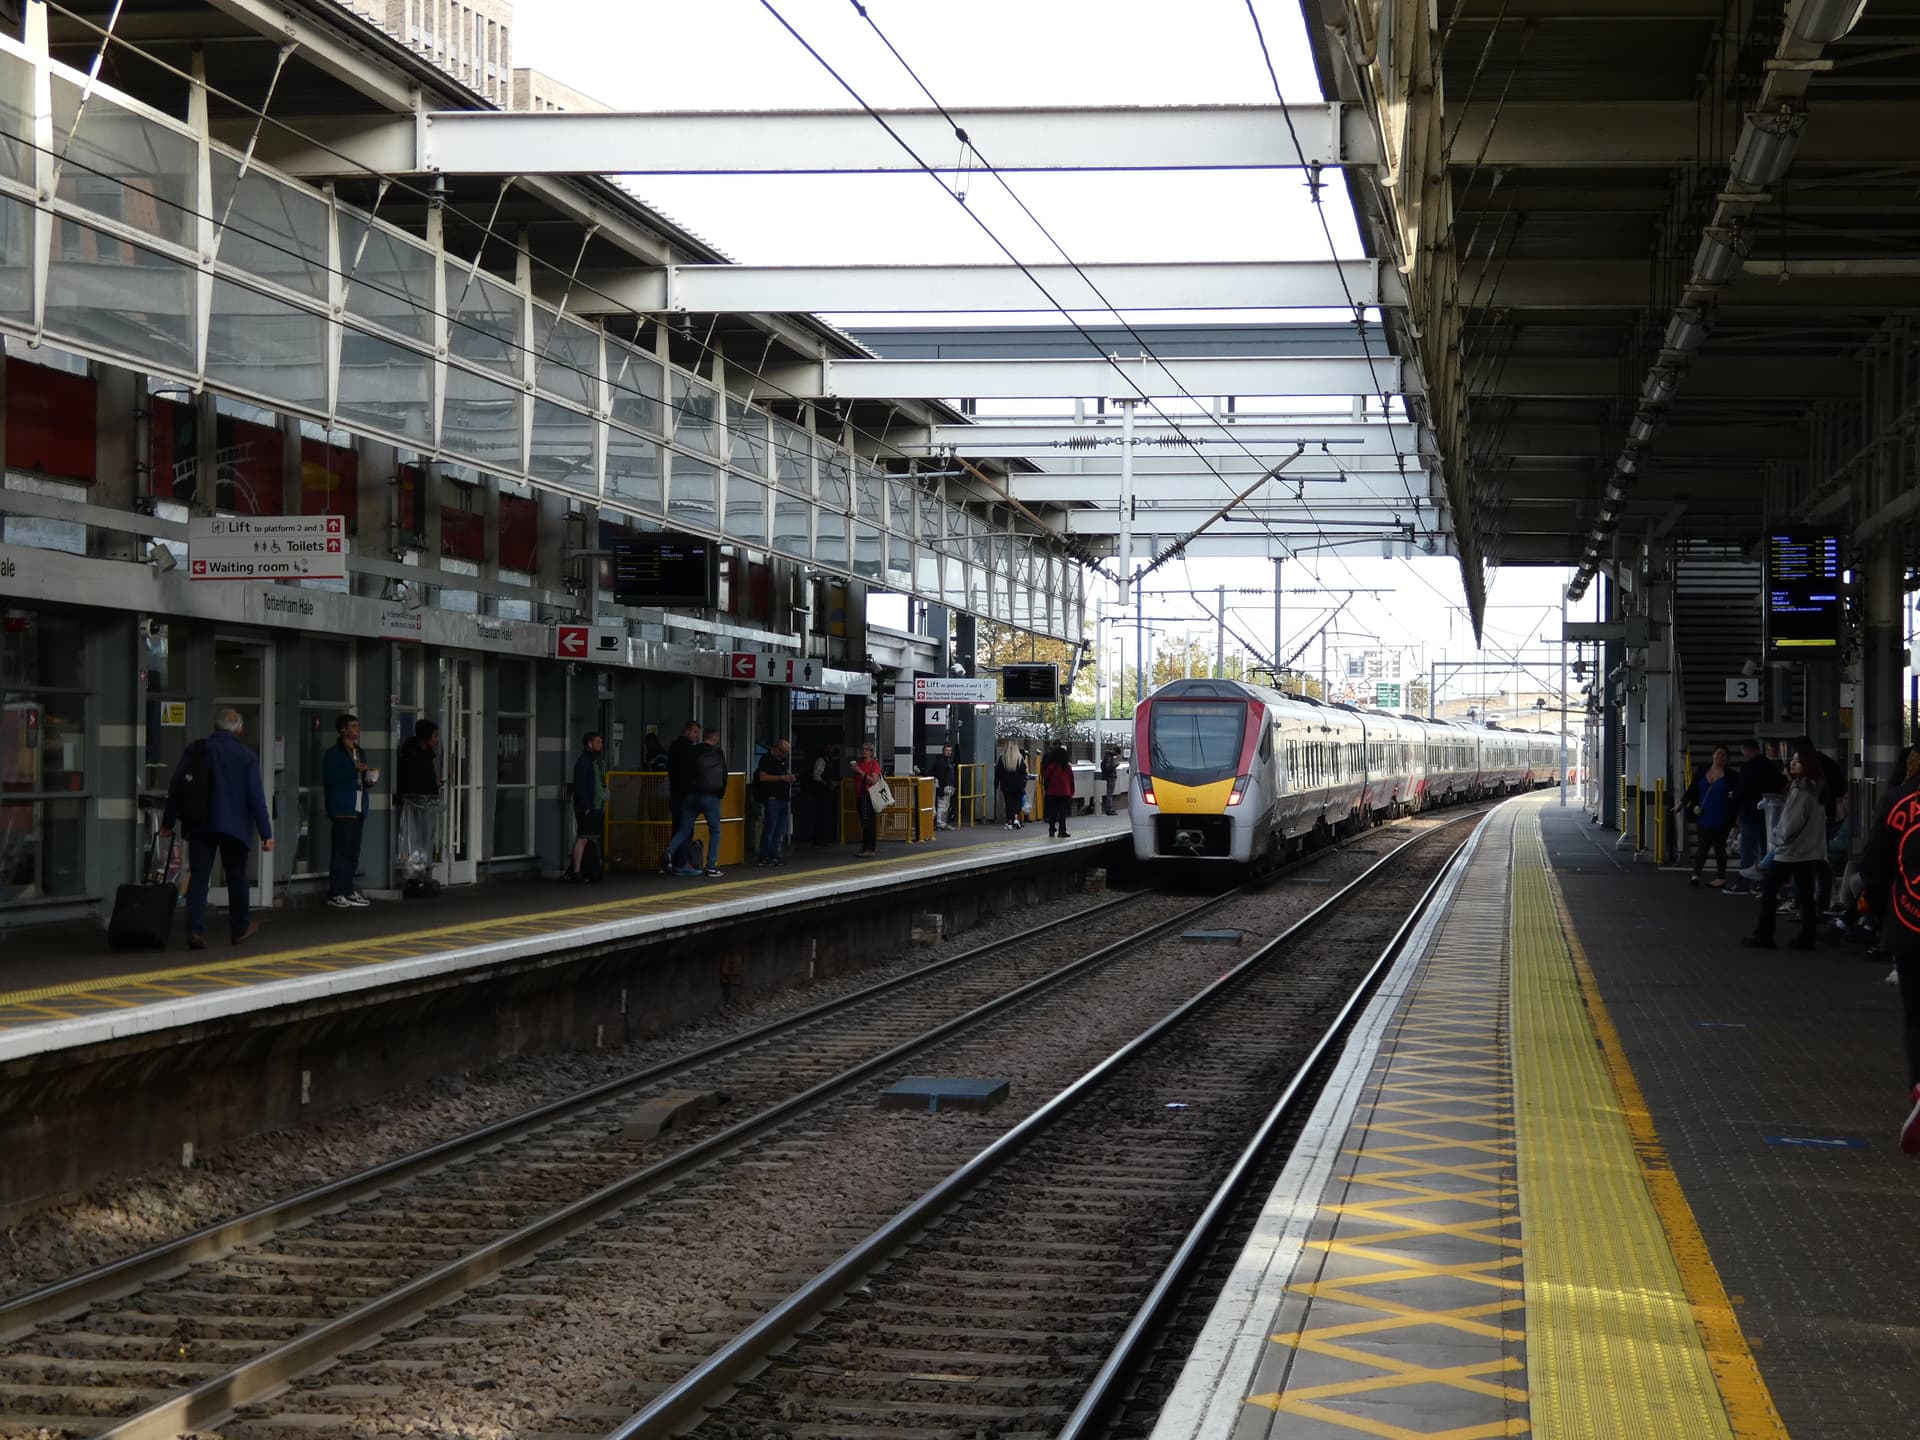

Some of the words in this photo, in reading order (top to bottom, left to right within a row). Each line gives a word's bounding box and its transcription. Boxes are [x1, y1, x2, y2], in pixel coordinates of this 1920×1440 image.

[229, 521, 250, 532] Lift
[264, 524, 295, 534] platform
[304, 524, 317, 532] and
[286, 540, 324, 552] Toilets
[0, 559, 15, 578] ale
[209, 561, 254, 574] Waiting
[258, 563, 289, 572] room
[263, 592, 298, 614] Tottenham
[299, 597, 314, 615] Hale
[476, 623, 500, 639] Tottenham
[501, 626, 512, 641] Hale
[926, 680, 939, 688] Lift
[1737, 681, 1748, 698] 3
[931, 710, 940, 722] 4
[1891, 801, 1920, 832] DA
[1899, 894, 1920, 919] SAIN
